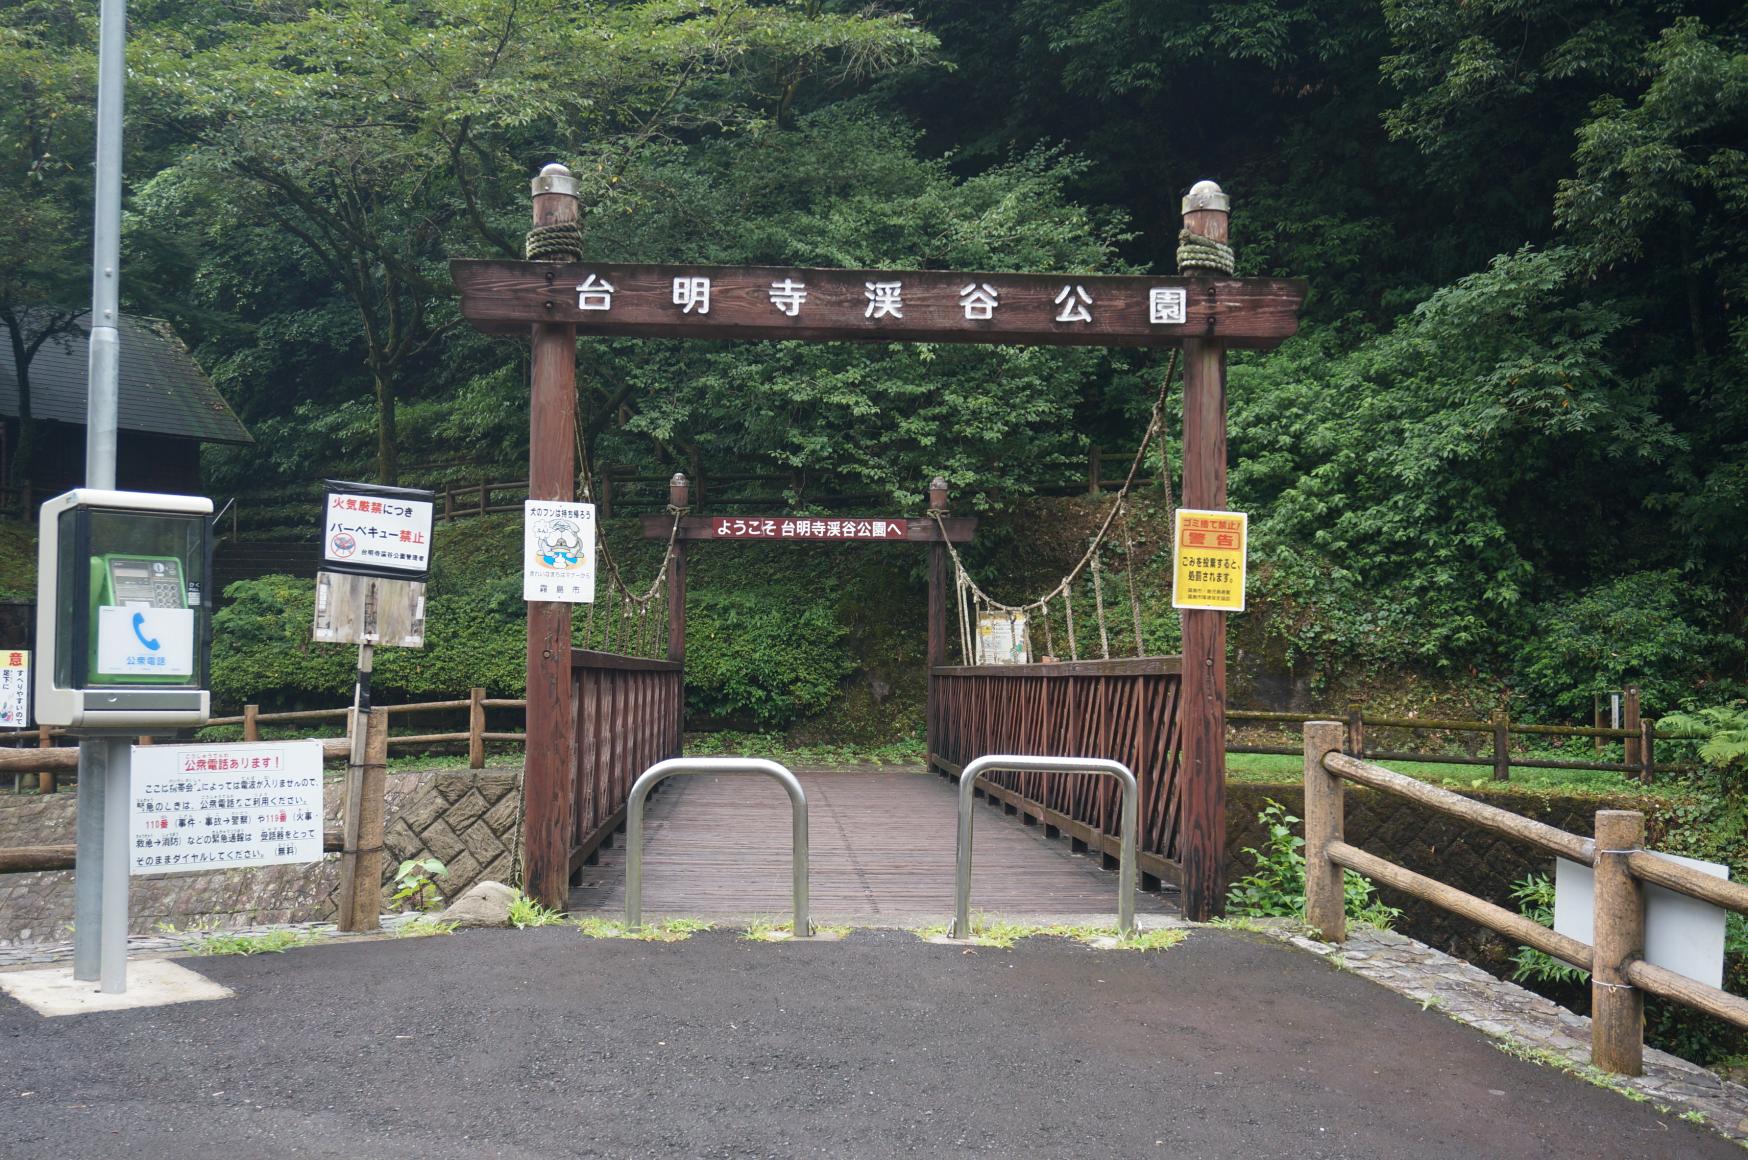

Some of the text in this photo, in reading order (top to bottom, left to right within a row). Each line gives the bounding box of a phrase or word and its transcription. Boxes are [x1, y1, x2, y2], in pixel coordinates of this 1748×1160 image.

[575, 273, 1188, 325] 台明寺渓谷公園
[332, 497, 413, 518] 火気厳禁につき
[330, 523, 425, 544] バーベキュー禁止
[717, 520, 902, 537] ようこそ 台明寺渓谷公園へ
[1188, 532, 1233, 547] 警告
[184, 756, 280, 772] 公衆電話あります！
